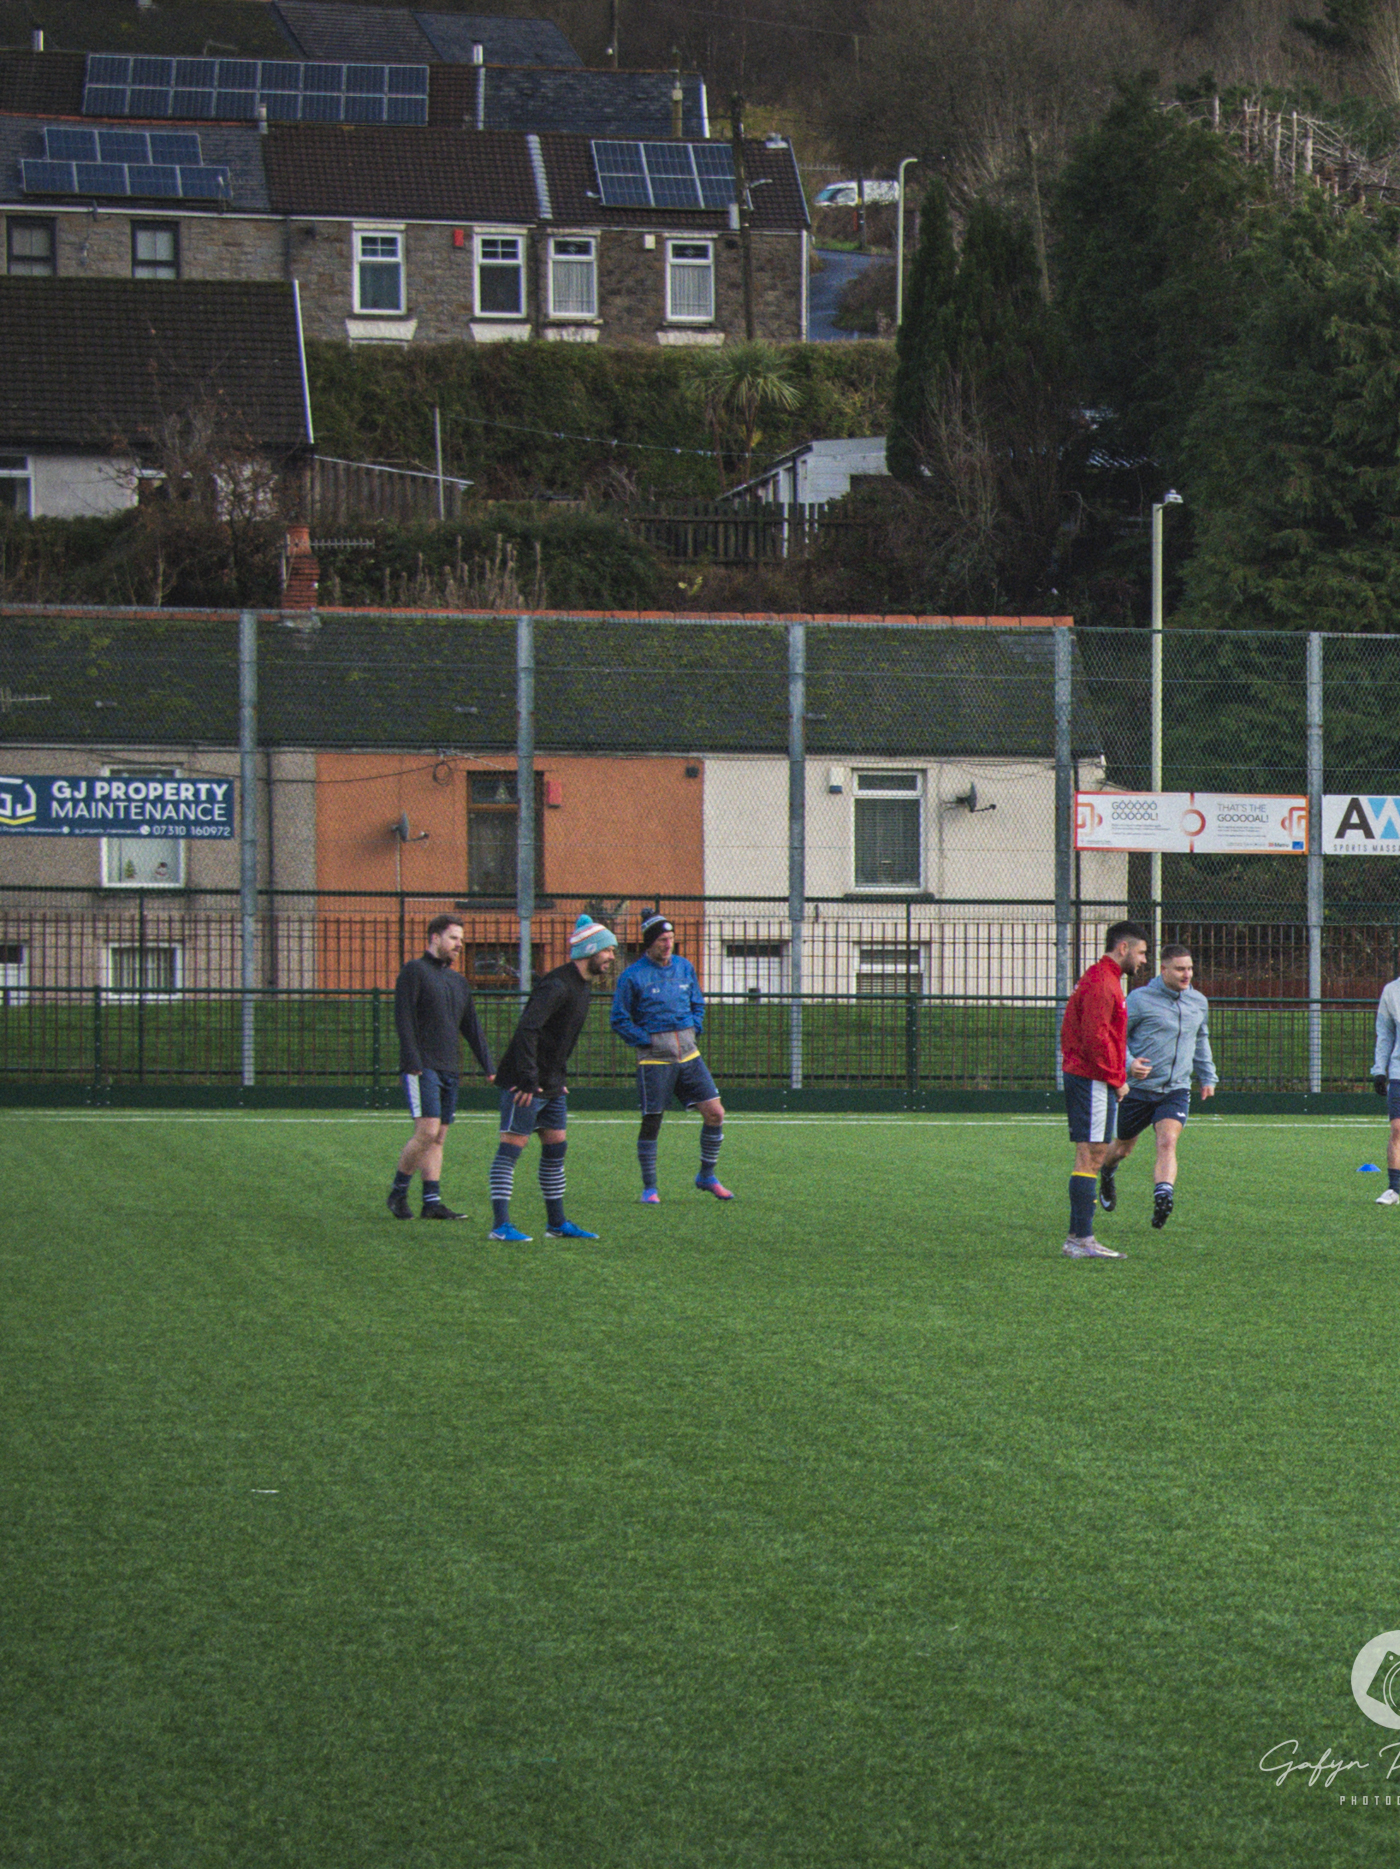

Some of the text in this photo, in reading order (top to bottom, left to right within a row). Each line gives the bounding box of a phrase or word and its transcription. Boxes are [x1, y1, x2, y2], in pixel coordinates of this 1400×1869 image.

[52, 781, 229, 801] GJ PROPERTY
[51, 801, 227, 821] MAINTENANCE
[1249, 804, 1267, 813] THE
[153, 825, 231, 837] 07310 160972
[1333, 844, 1368, 852] SPORTS
